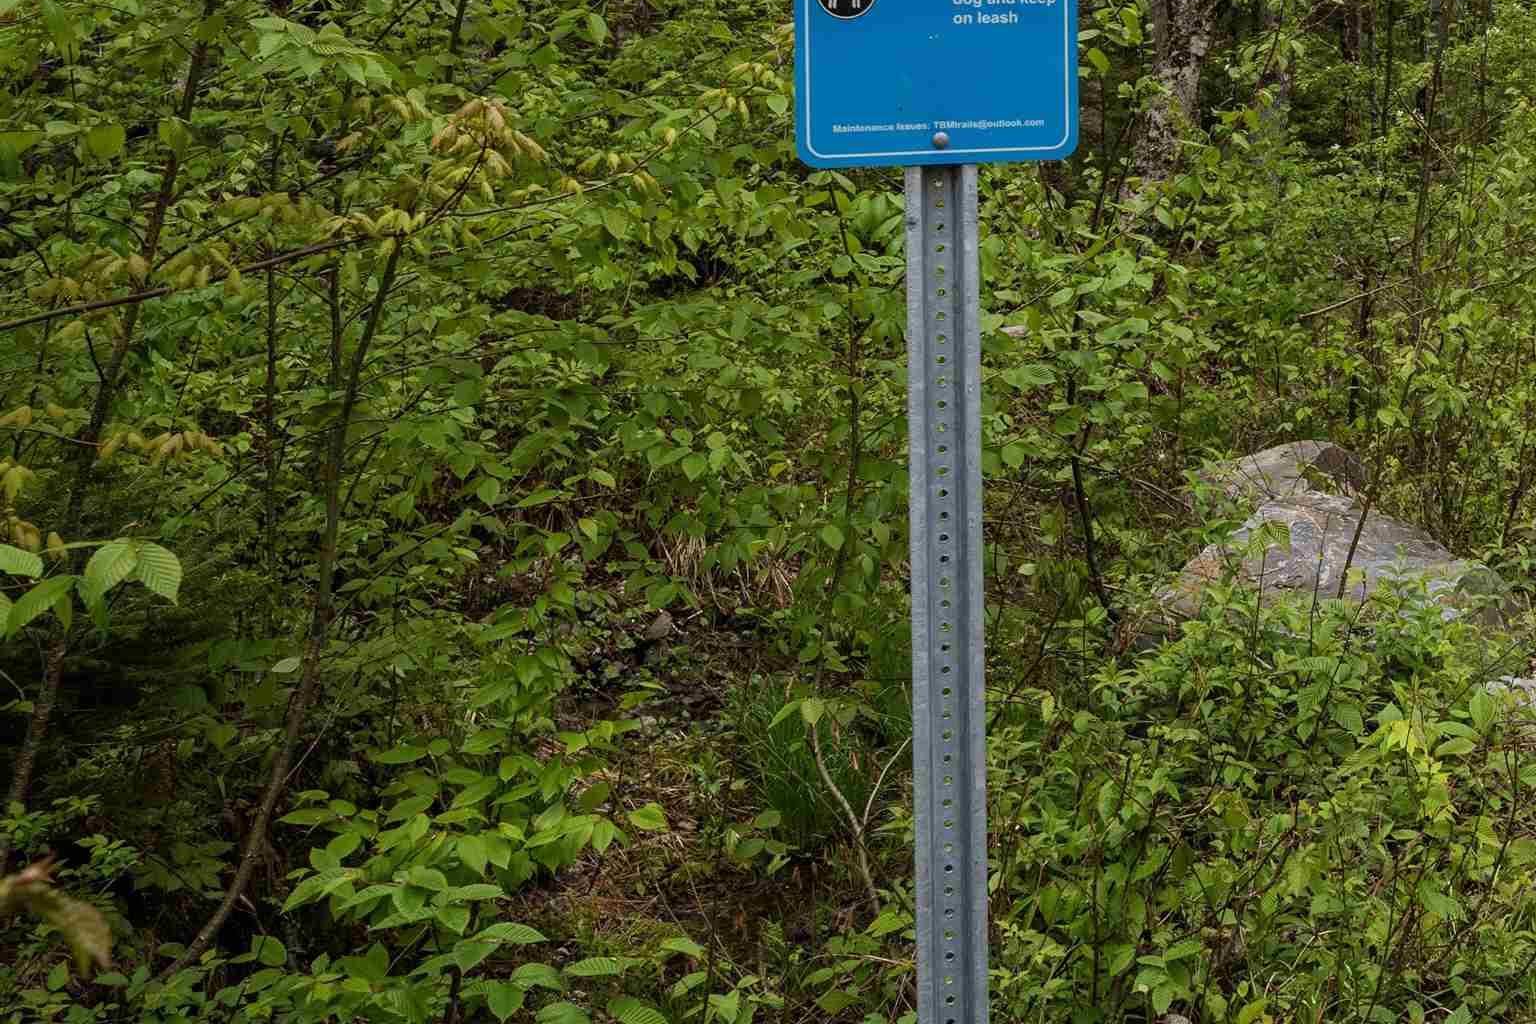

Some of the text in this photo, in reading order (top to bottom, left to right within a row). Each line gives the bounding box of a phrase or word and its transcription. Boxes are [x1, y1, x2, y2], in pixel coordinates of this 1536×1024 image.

[952, 10, 1018, 25] on leash
[832, 123, 895, 133] Maintenance
